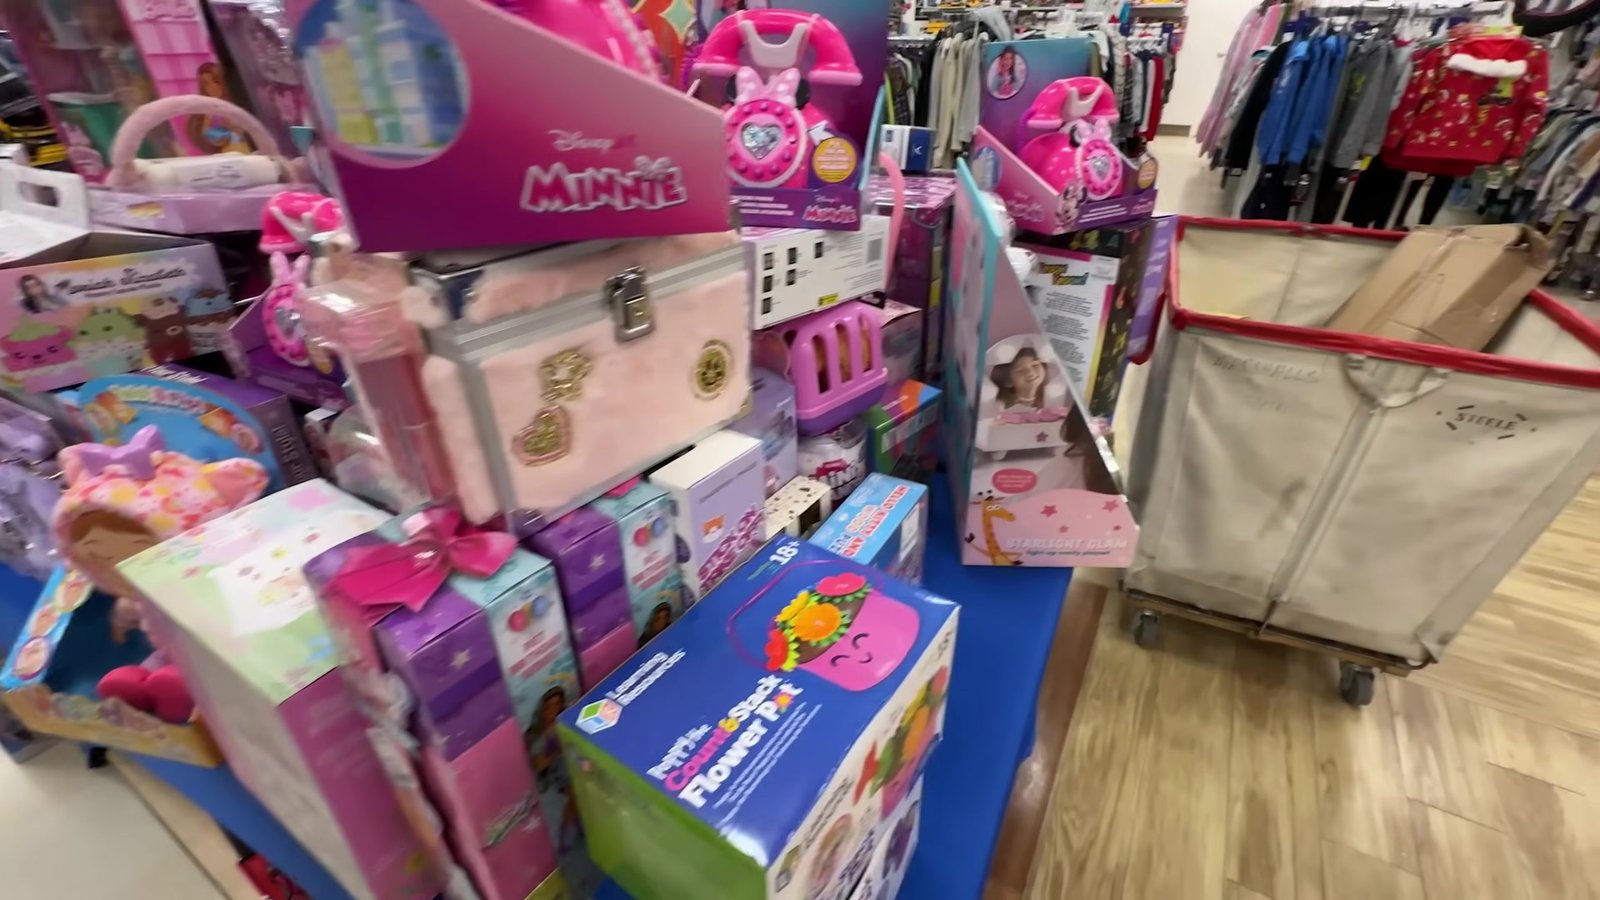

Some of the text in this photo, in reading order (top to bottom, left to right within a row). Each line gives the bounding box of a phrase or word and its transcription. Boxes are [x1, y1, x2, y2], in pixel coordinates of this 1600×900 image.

[547, 129, 613, 153] Disney
[519, 155, 688, 213] MINNIE
[1455, 412, 1518, 431] STEELE
[843, 485, 909, 557] HELLO KITTY AND
[1006, 538, 1127, 549] STARLIGHT GLAM
[769, 540, 800, 566] 18+
[605, 652, 669, 699] Learning
[616, 648, 686, 706] Resources
[678, 718, 768, 808] Flower
[754, 683, 804, 722] Pot
